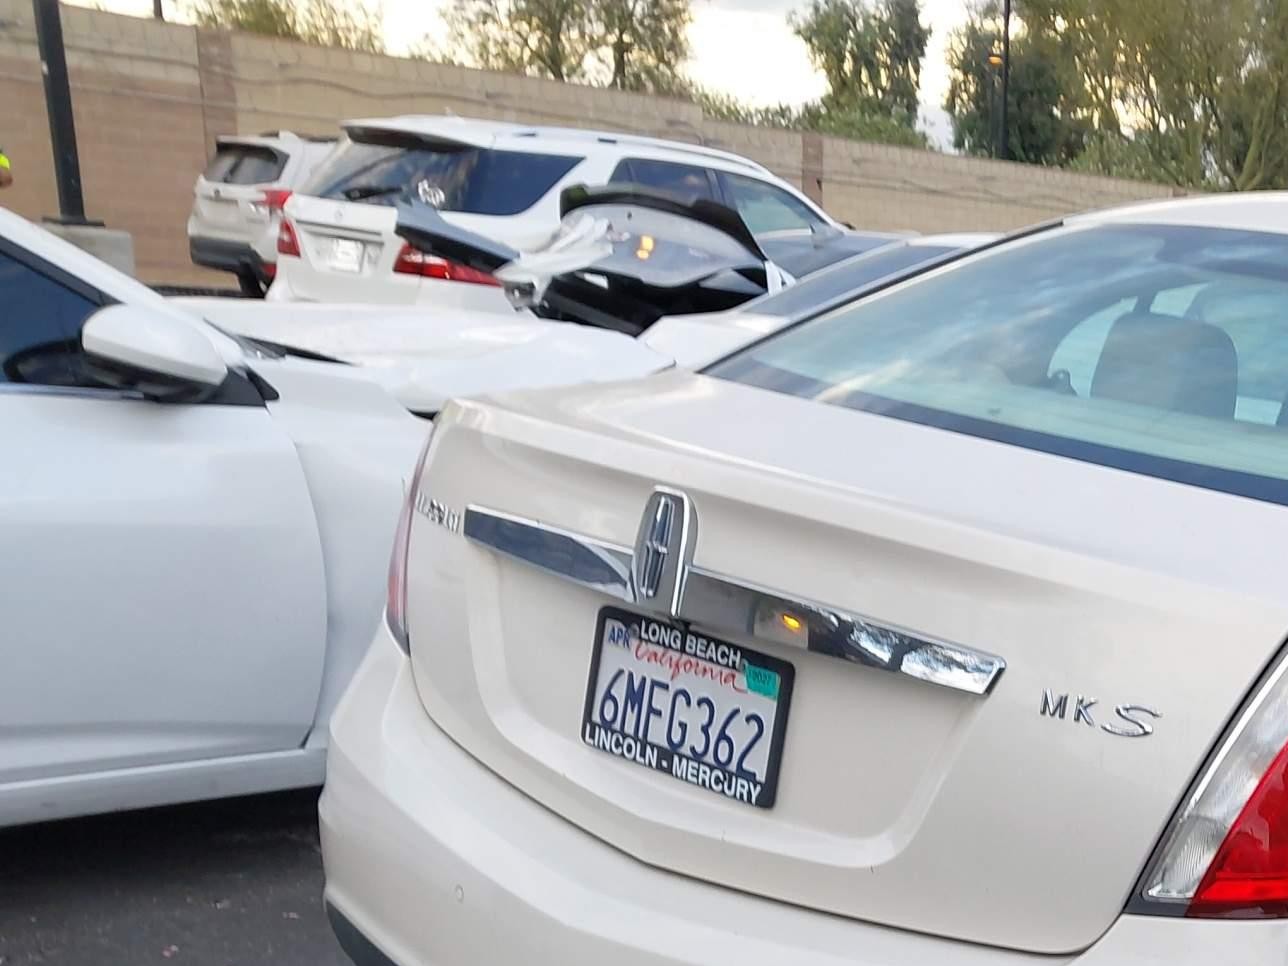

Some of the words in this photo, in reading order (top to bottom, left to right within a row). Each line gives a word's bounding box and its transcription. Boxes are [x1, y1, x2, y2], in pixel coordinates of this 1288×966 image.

[634, 641, 749, 692] California
[640, 618, 682, 650] LONG
[685, 635, 741, 670] BEACH
[599, 668, 764, 780] 6MFG362
[1040, 687, 1162, 738] MKS
[585, 721, 658, 769] LINCOLN
[672, 756, 762, 805] MERCURY
